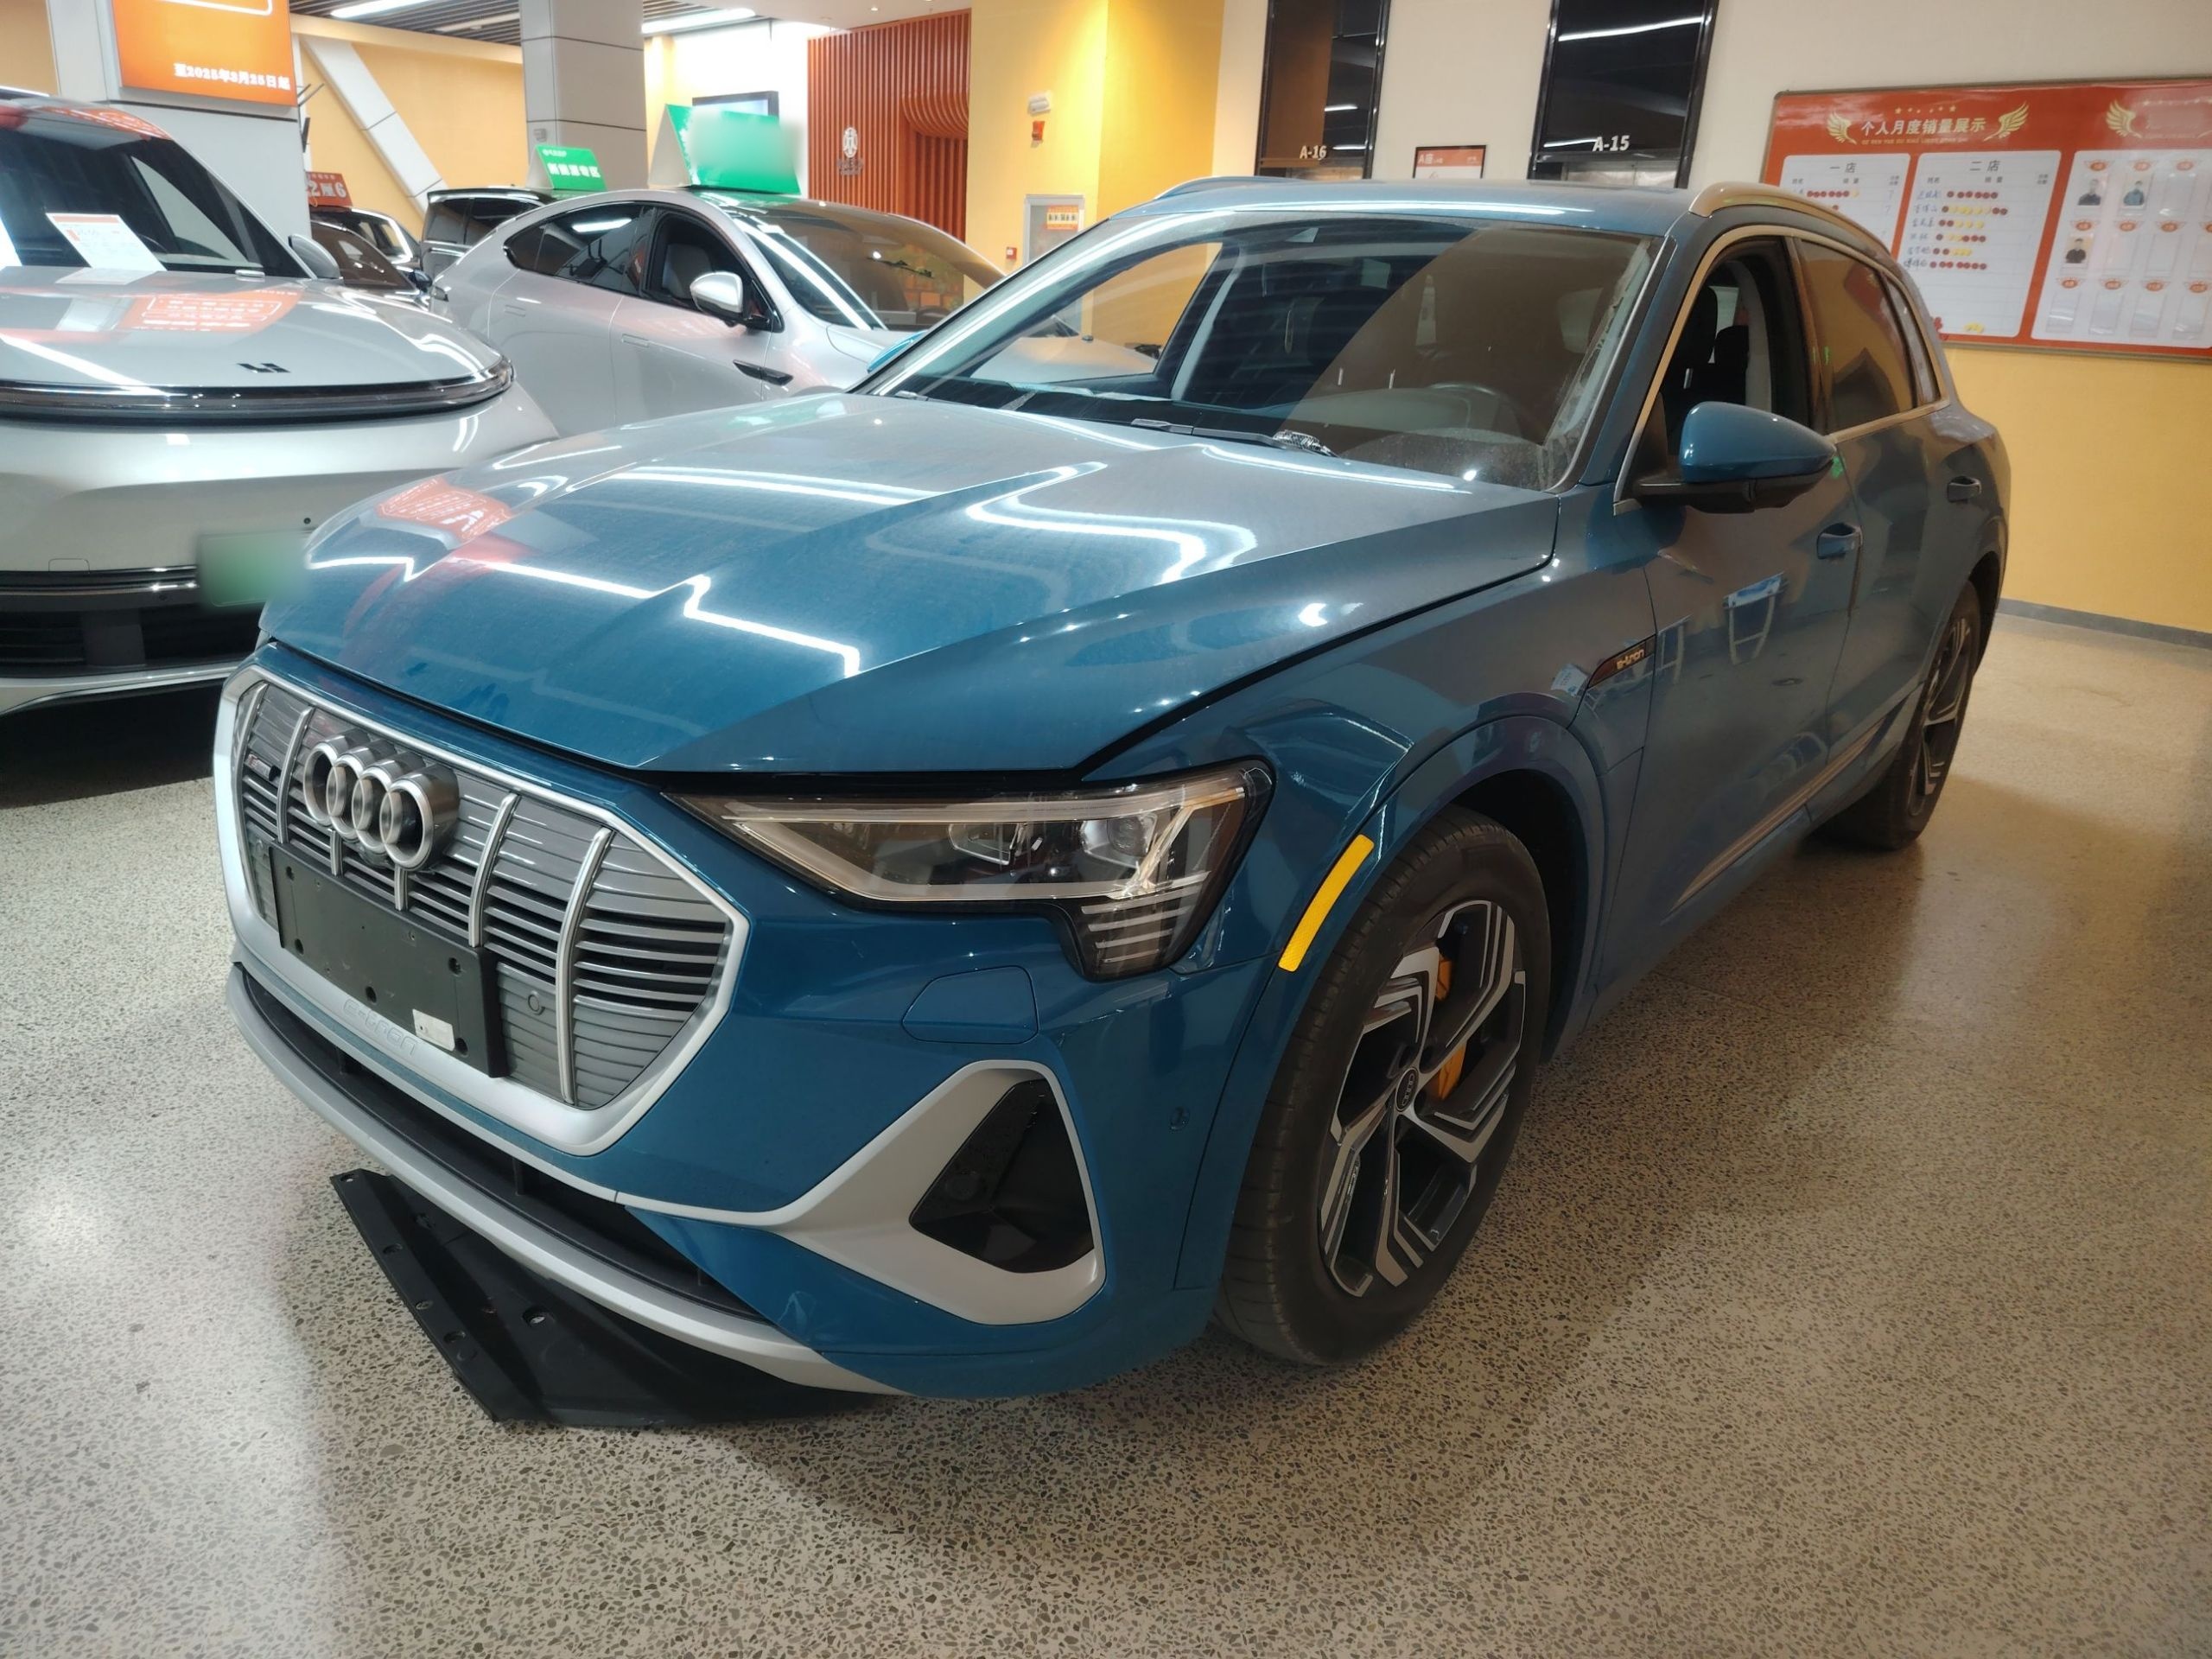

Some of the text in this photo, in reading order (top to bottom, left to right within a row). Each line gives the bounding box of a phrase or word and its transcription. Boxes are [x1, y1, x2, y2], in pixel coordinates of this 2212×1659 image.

[1861, 118, 1986, 136] 个人月度销量展示
[1592, 135, 1630, 152] A-15
[1300, 145, 1327, 160] A-16
[1969, 160, 2001, 172] 二店
[1616, 649, 1645, 670] e-tron
[343, 997, 418, 1057] e-tron
